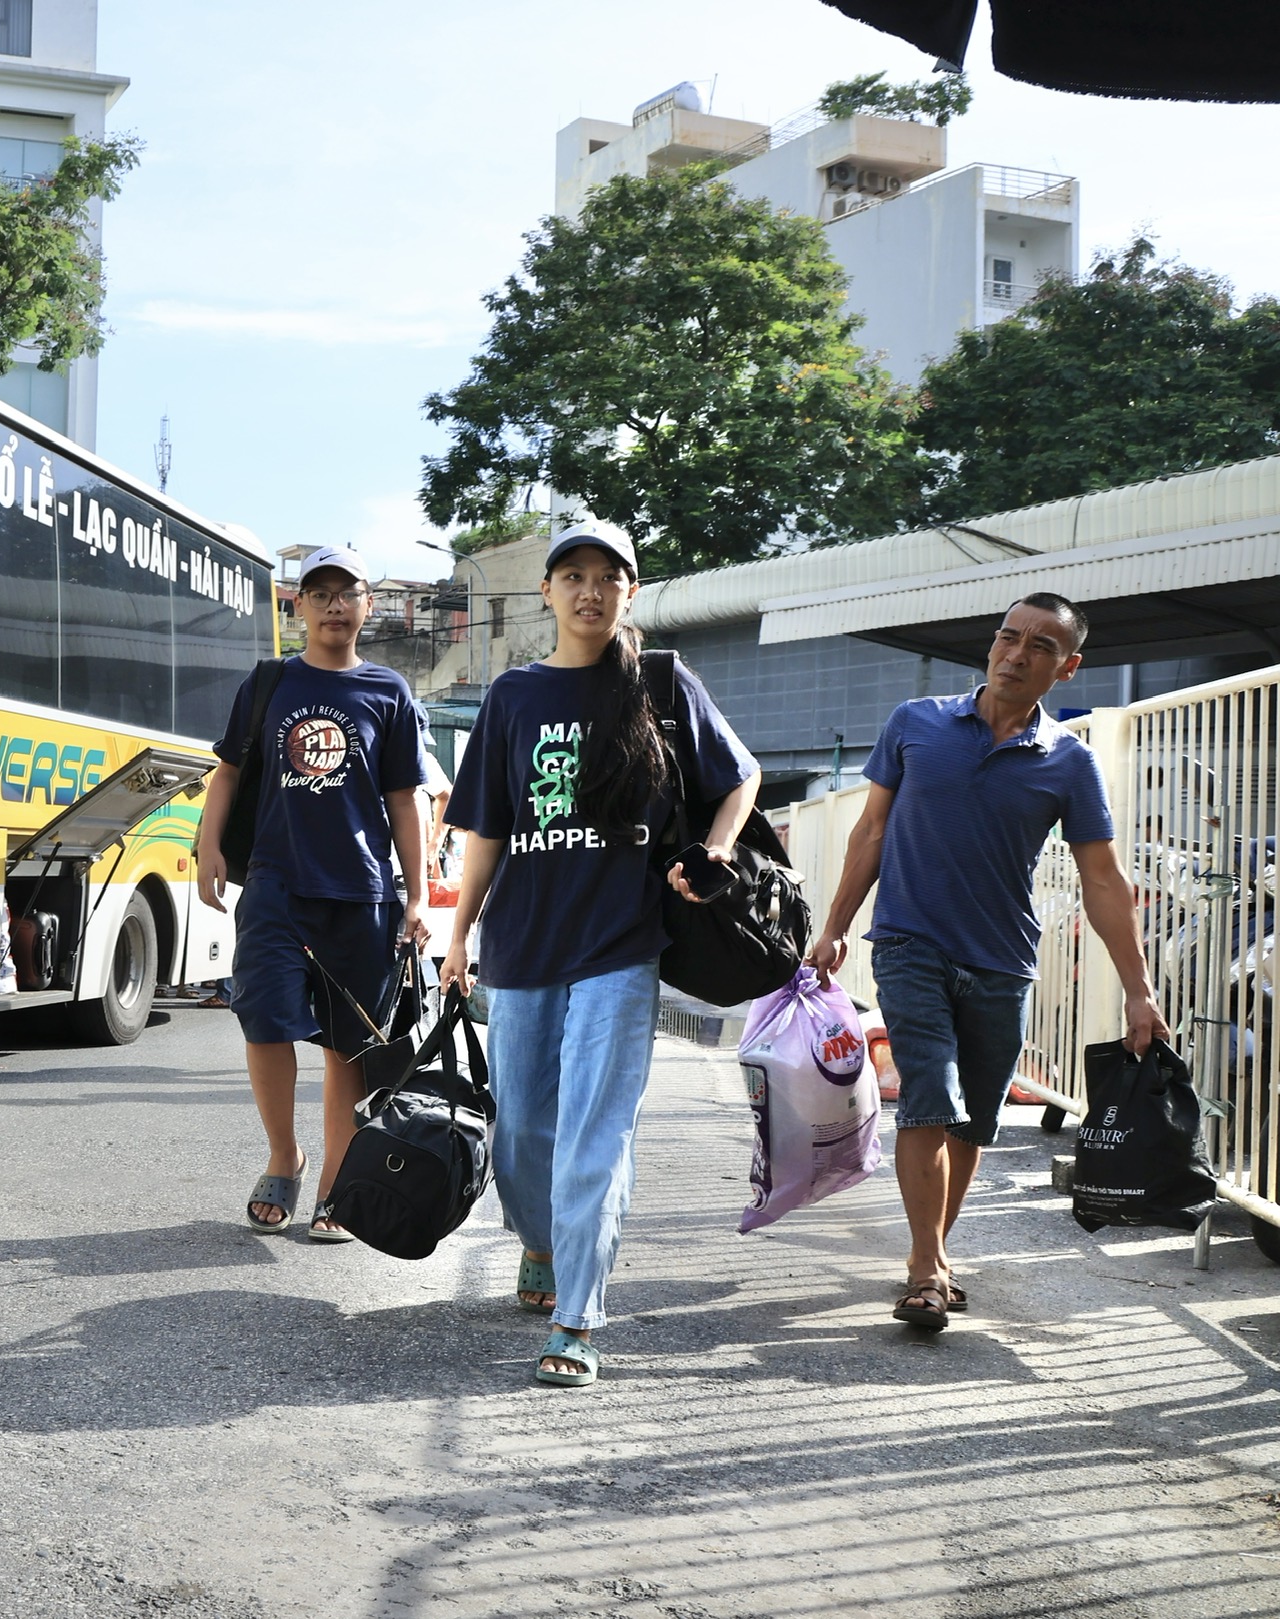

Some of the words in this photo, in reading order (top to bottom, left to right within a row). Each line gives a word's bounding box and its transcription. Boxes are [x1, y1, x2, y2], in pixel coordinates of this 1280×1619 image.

[122, 517, 177, 582] QUẦN
[190, 545, 220, 601] HẢI
[222, 564, 254, 619] HẬU
[282, 717, 294, 728] TO
[292, 706, 309, 720] WIN
[319, 705, 349, 725] REFUSE
[277, 728, 287, 748] PLAY
[345, 723, 358, 735] TO
[349, 737, 360, 757] LOSE
[310, 772, 348, 795] Quit
[510, 823, 650, 856] HAPPED
